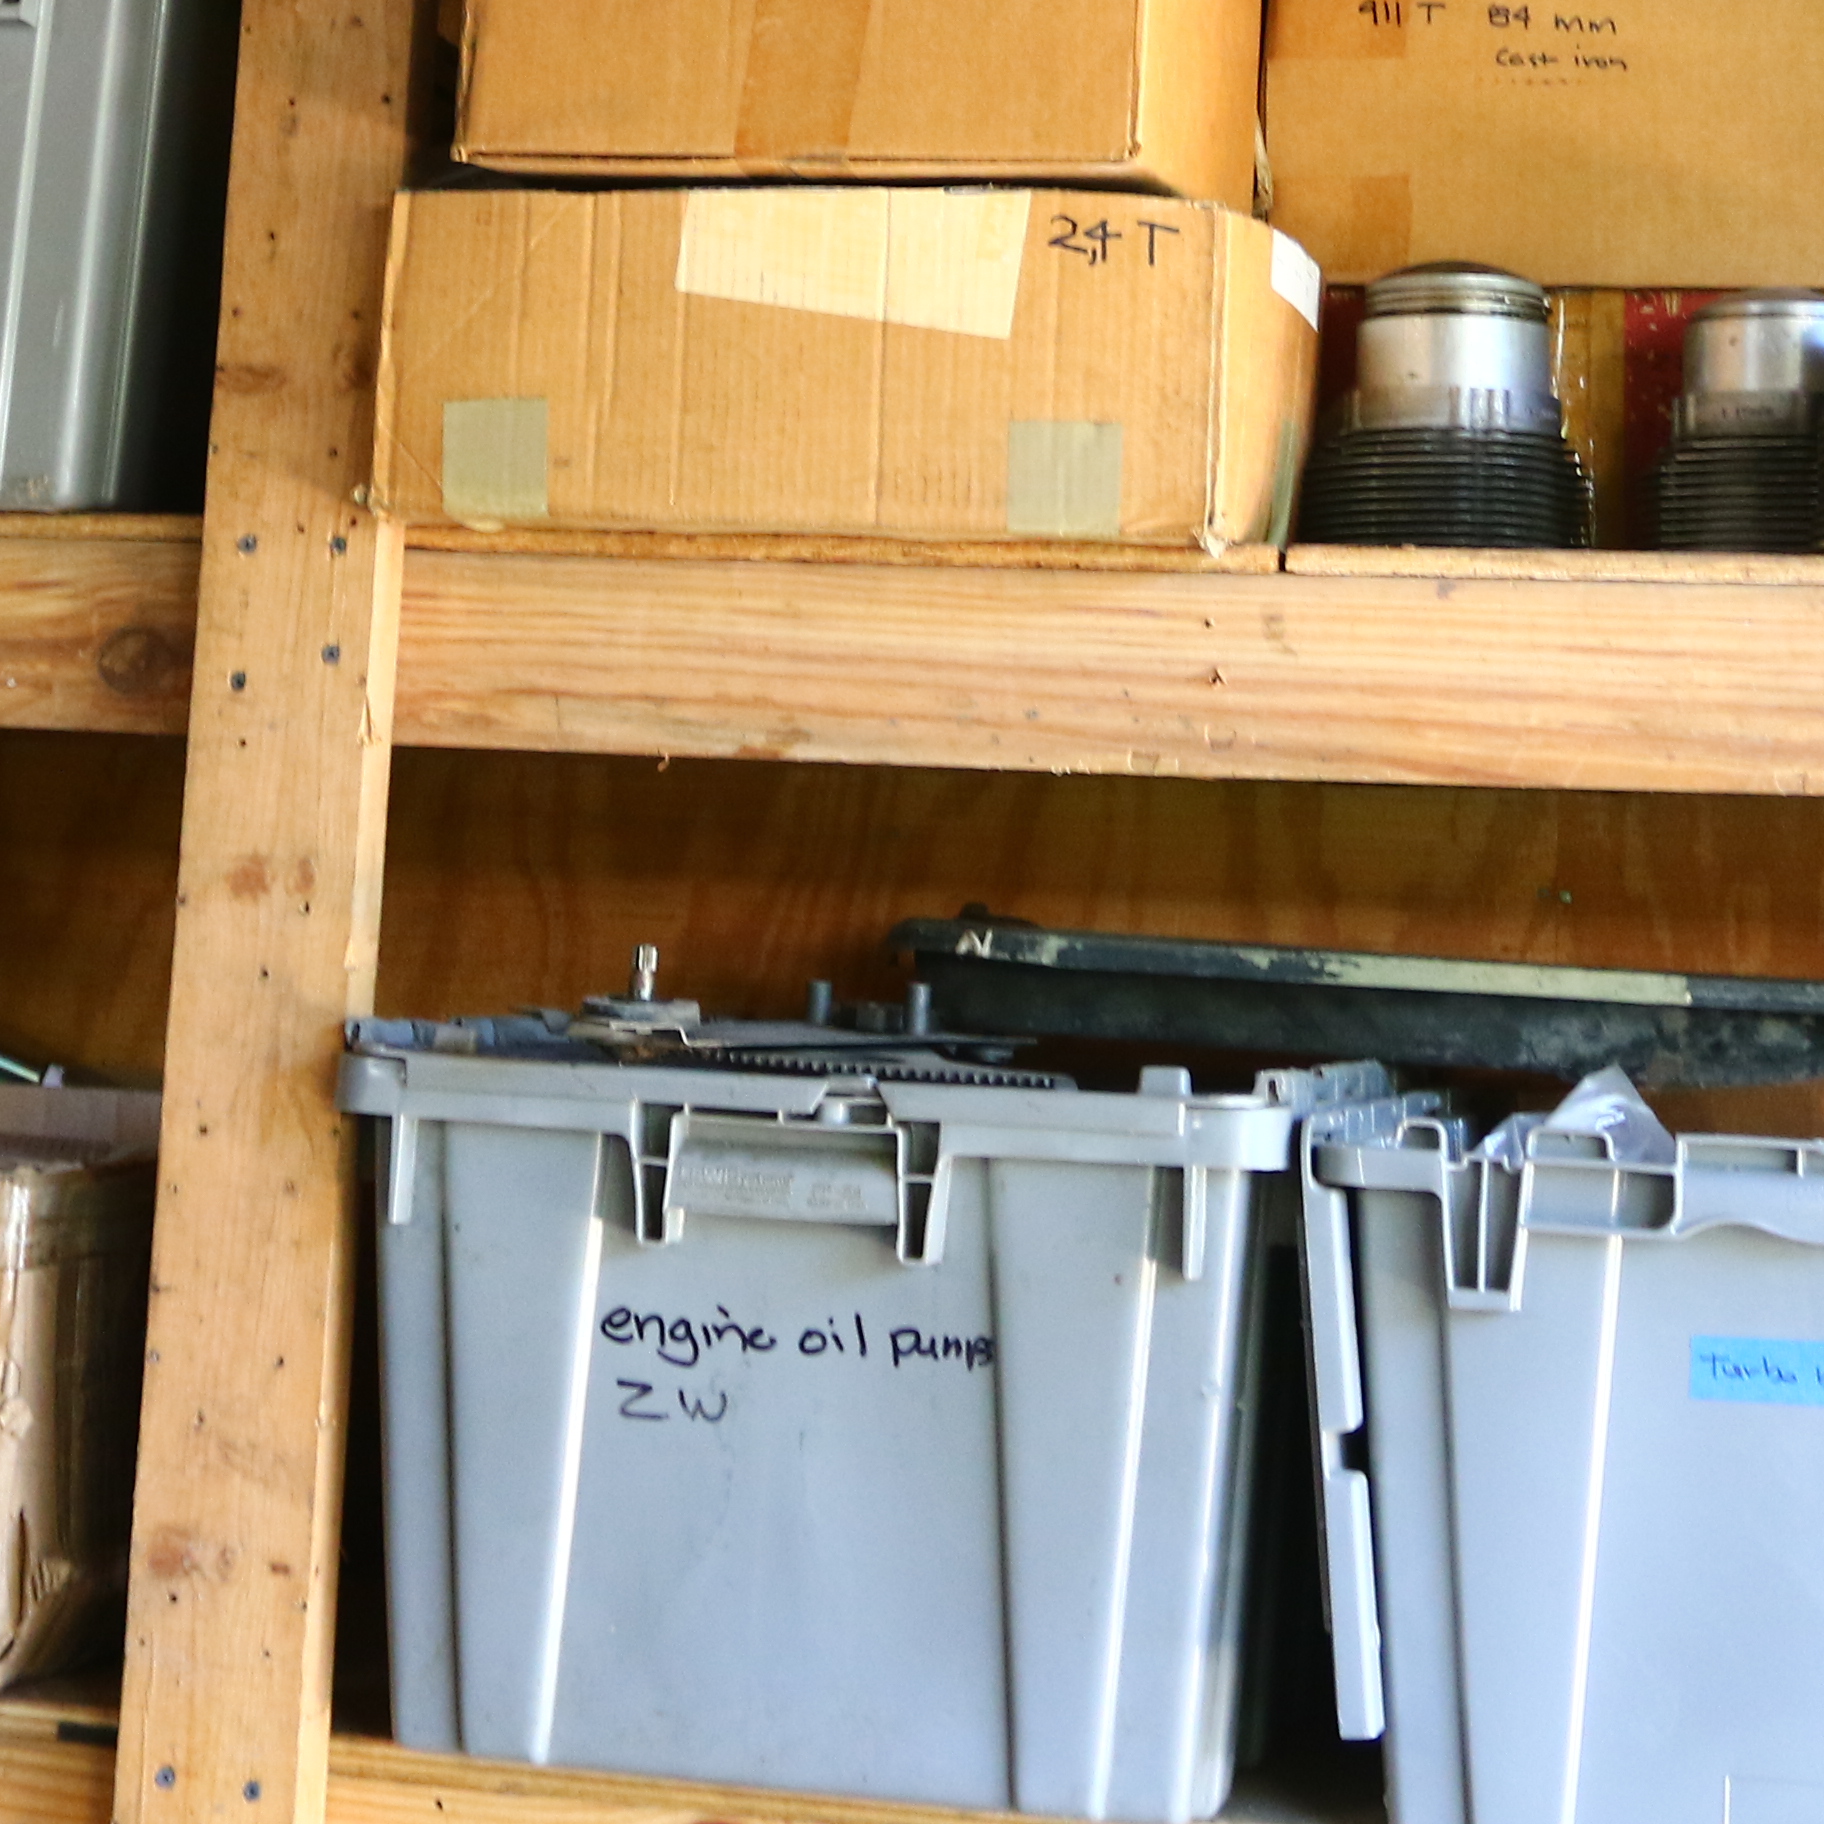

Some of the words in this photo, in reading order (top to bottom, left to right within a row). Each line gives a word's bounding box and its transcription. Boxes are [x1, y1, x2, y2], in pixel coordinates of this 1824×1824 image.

[1358, 0, 1402, 26] 911
[1417, 1, 1446, 25] T
[1137, 219, 1180, 268] T
[600, 1305, 777, 1368] engine
[798, 1312, 868, 1358] oil
